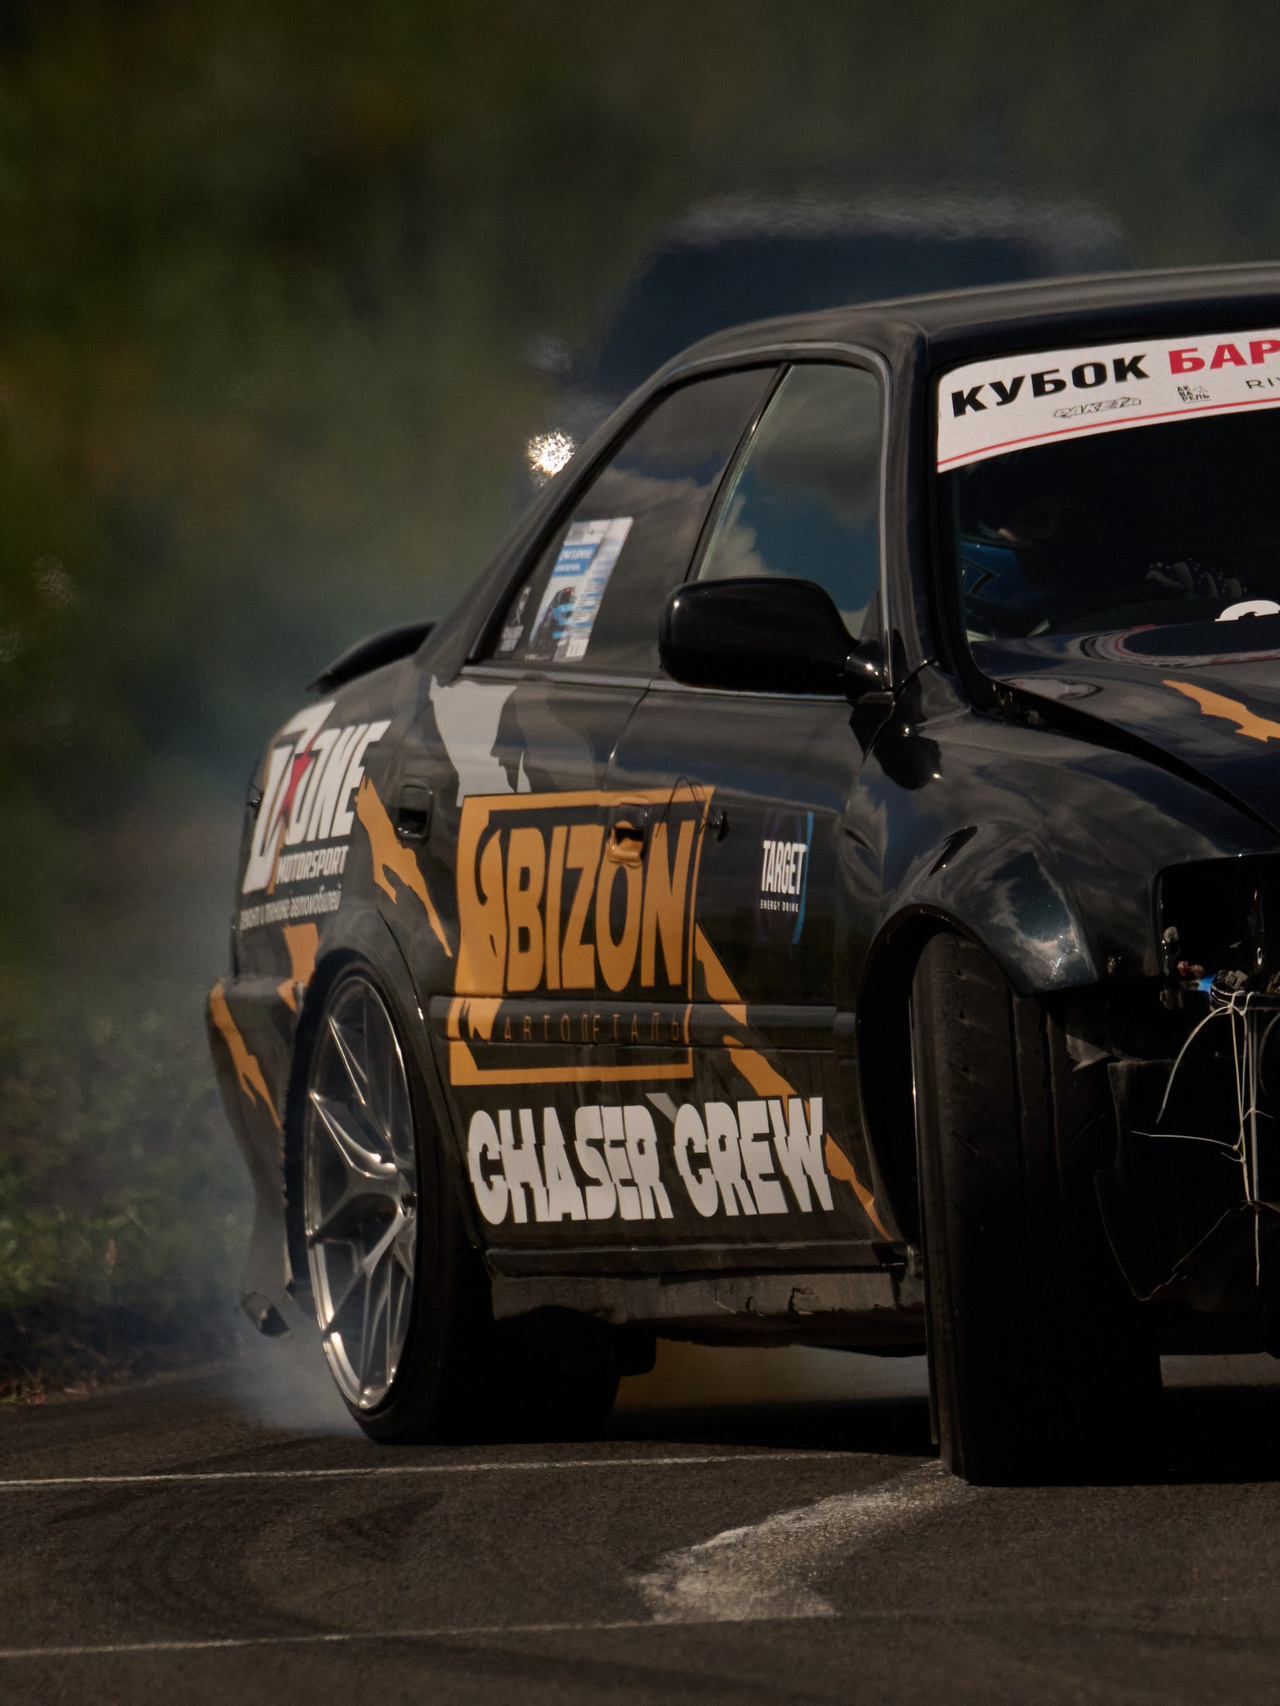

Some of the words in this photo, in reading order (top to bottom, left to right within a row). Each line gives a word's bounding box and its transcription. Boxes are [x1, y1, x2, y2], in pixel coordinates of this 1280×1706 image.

[950, 353, 1149, 417] КУБОК
[1053, 397, 1141, 418] РАКЕТА
[276, 845, 349, 884] MOTORSPORT
[761, 840, 808, 895] TARGET
[506, 820, 697, 992] BIZON
[760, 899, 780, 911] ENERGY
[782, 901, 799, 913] DRINK
[468, 1105, 674, 1226] CHASER
[673, 1097, 835, 1218] CREW
